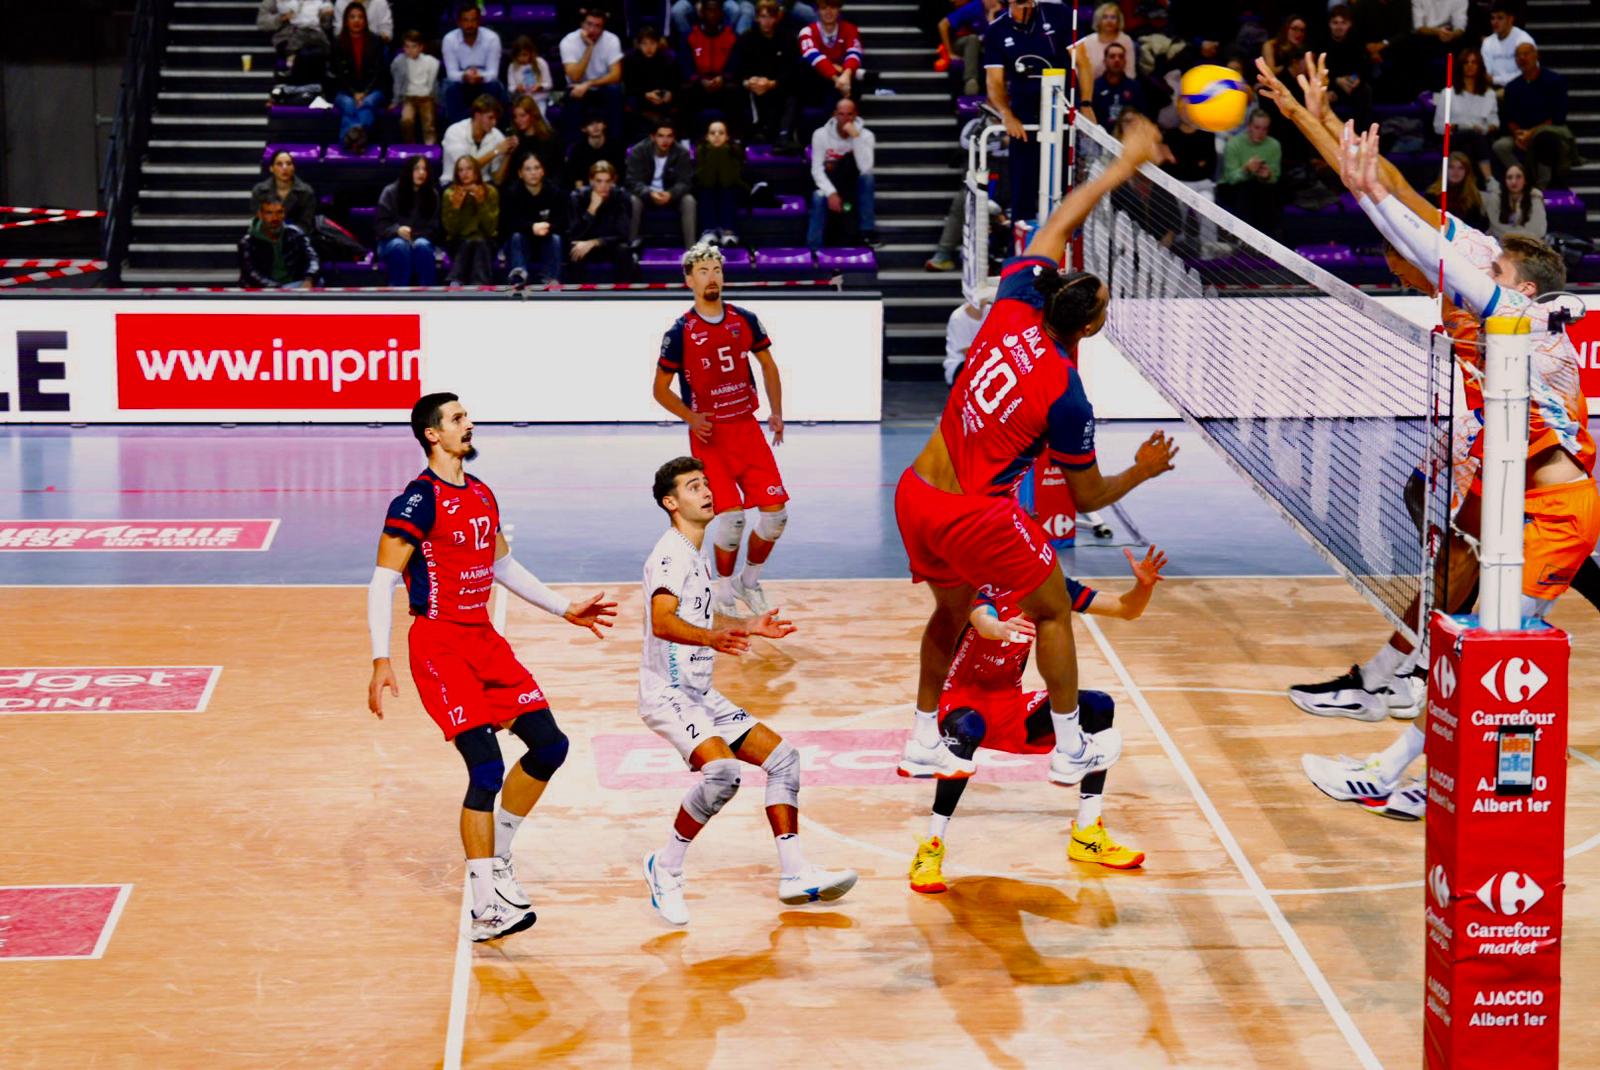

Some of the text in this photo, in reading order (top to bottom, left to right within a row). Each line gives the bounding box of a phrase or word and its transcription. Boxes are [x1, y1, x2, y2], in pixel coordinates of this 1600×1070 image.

[717, 346, 735, 373] 5
[0, 331, 70, 412] E
[969, 346, 1018, 415] 10
[469, 516, 491, 551] 12
[1039, 543, 1054, 566] 10
[448, 705, 467, 727] 12
[1471, 709, 1556, 726] Carrefour
[686, 724, 700, 740] 2
[1472, 799, 1551, 813] Albert 1er
[1466, 922, 1550, 939] Carrefour
[1478, 940, 1538, 956] market
[1474, 991, 1544, 1007] AJACCIO
[1469, 1012, 1547, 1027] Albert 1er
